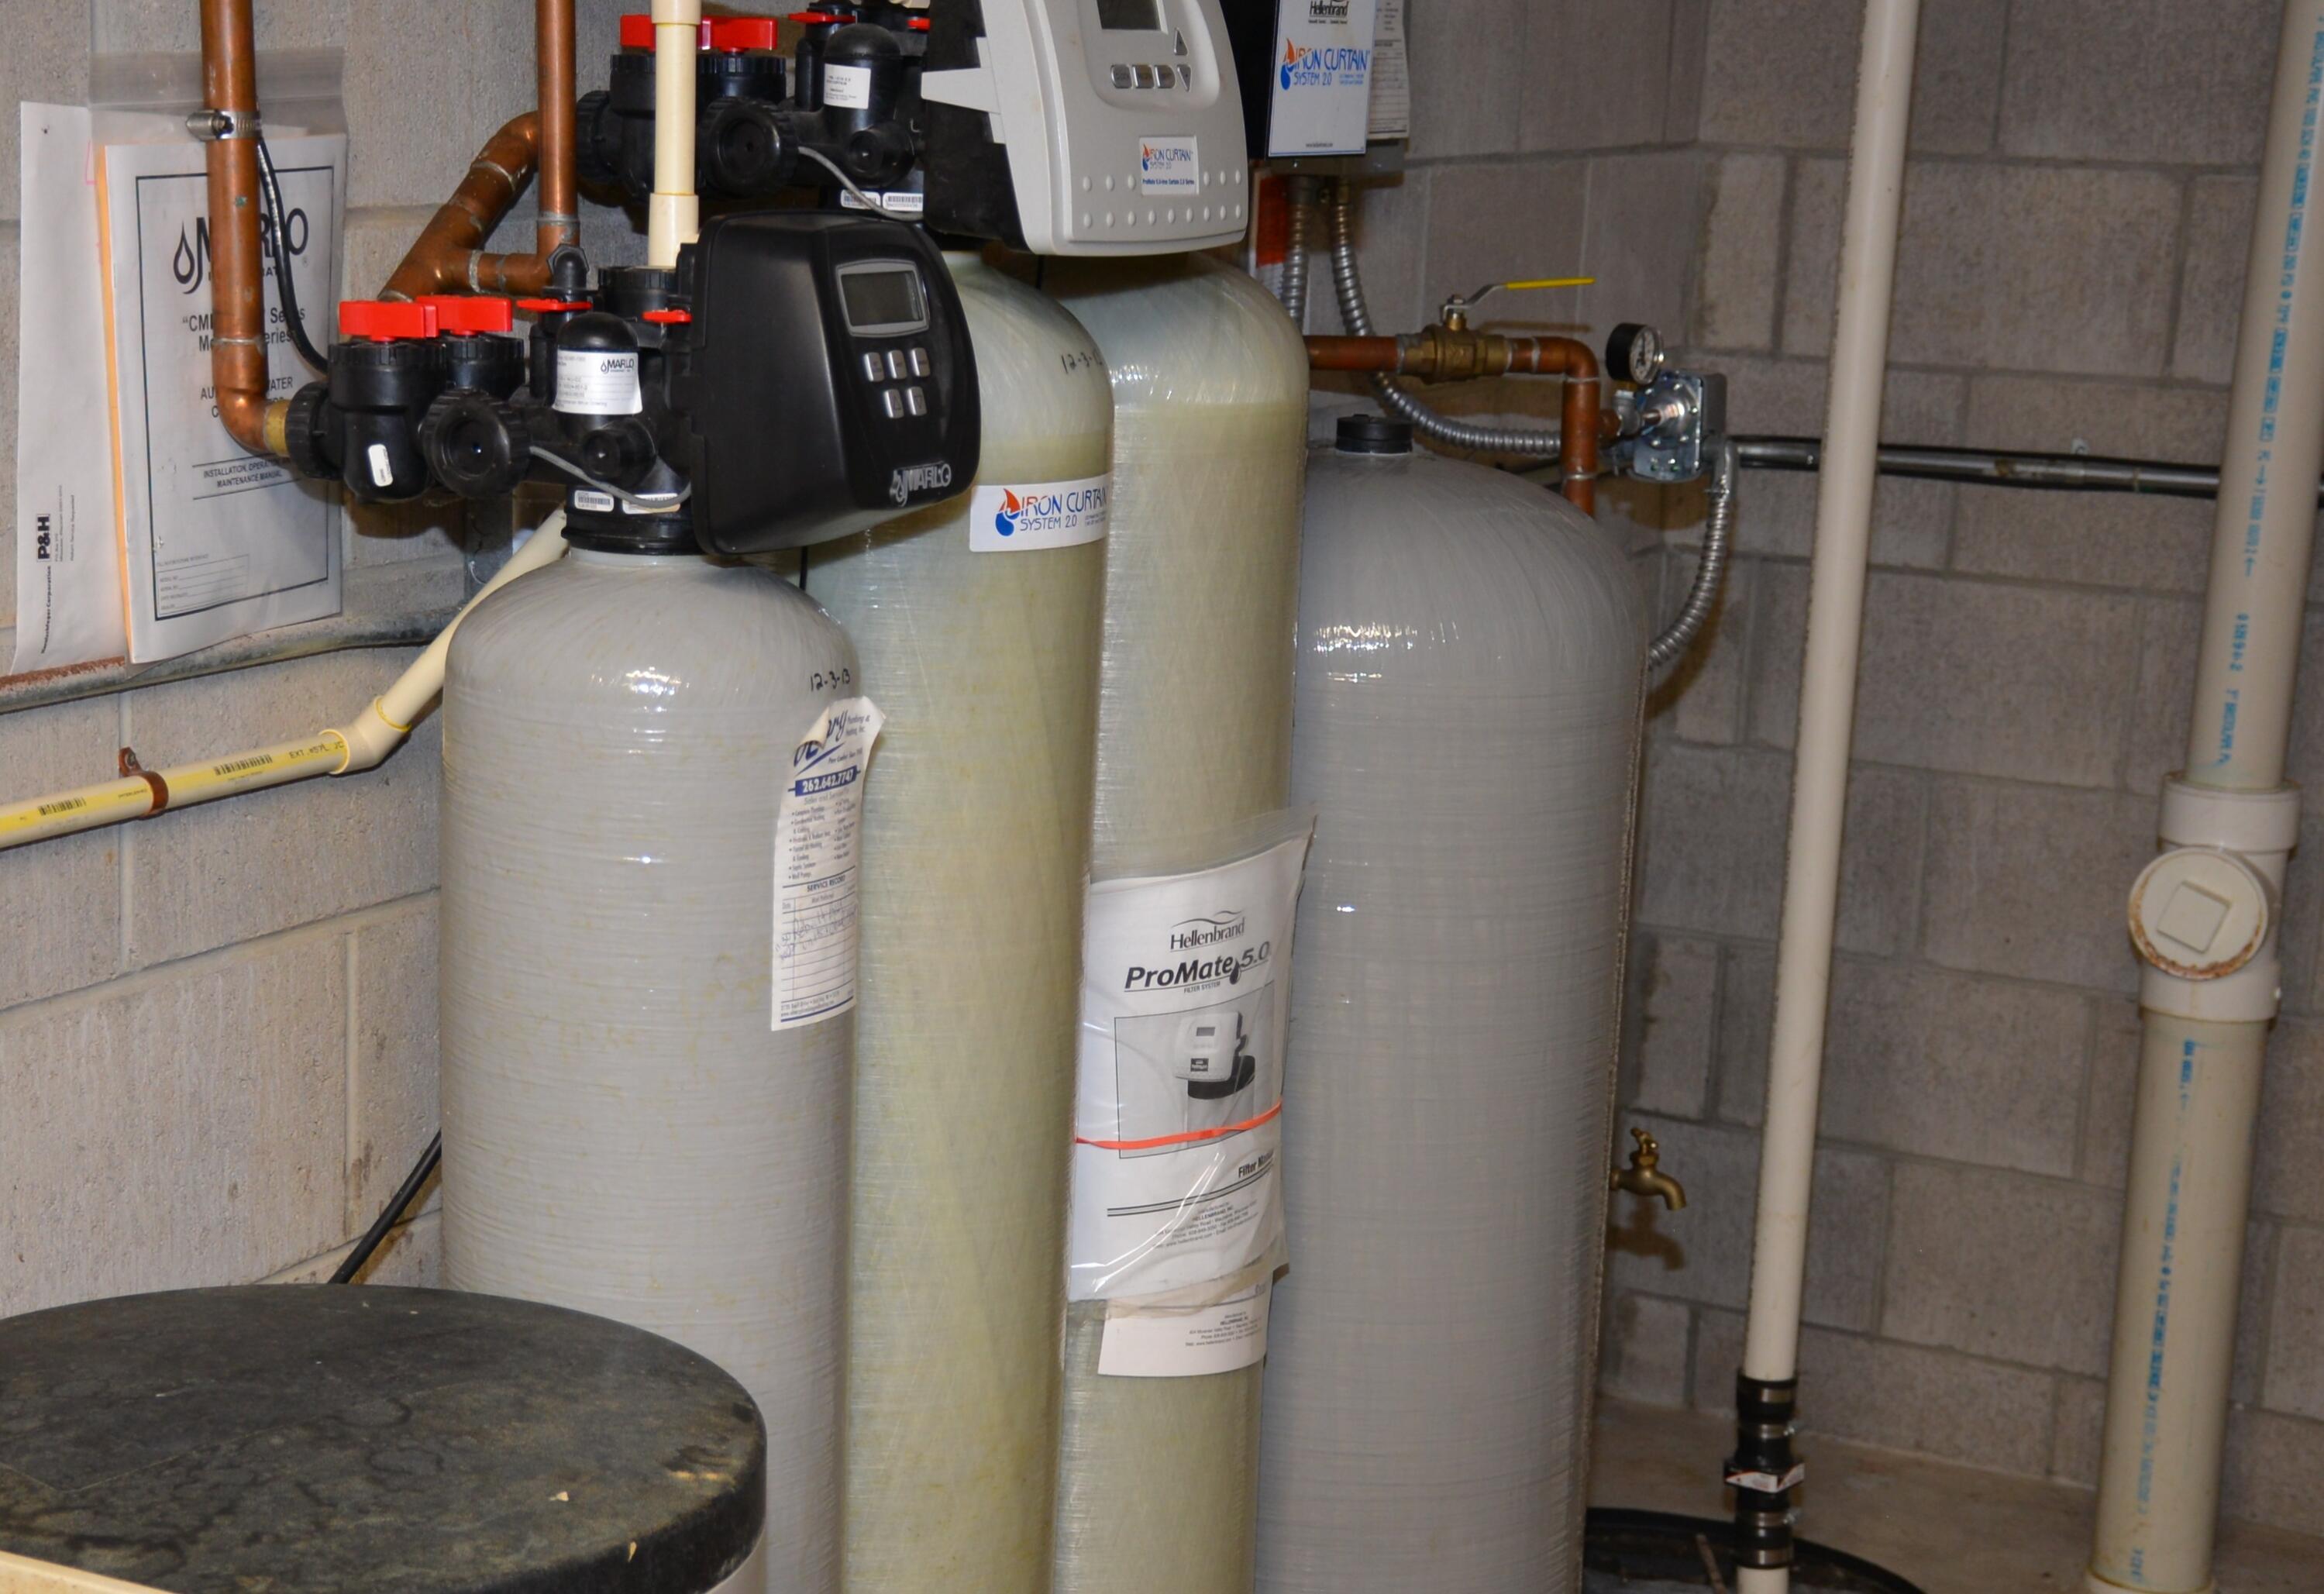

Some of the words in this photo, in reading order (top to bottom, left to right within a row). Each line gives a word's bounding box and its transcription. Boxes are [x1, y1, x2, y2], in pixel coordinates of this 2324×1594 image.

[1294, 48, 1322, 70] IRON
[1324, 48, 1367, 71] CURTAIN
[1293, 72, 1320, 85] SYSTEM
[604, 358, 635, 374] MARLO
[269, 376, 294, 391] ATER
[897, 463, 952, 507] MARLO
[1021, 494, 1062, 517] IRON
[1020, 516, 1062, 531] SYSTEM
[36, 515, 51, 561] P&H
[1170, 917, 1245, 950] Hellenbrand
[1124, 955, 1234, 989] ProMate
[1240, 940, 1271, 968] 5.0
[1184, 983, 1200, 993] FILTER
[1201, 981, 1221, 992] SYSTEM
[1238, 1162, 1257, 1179] Filter
